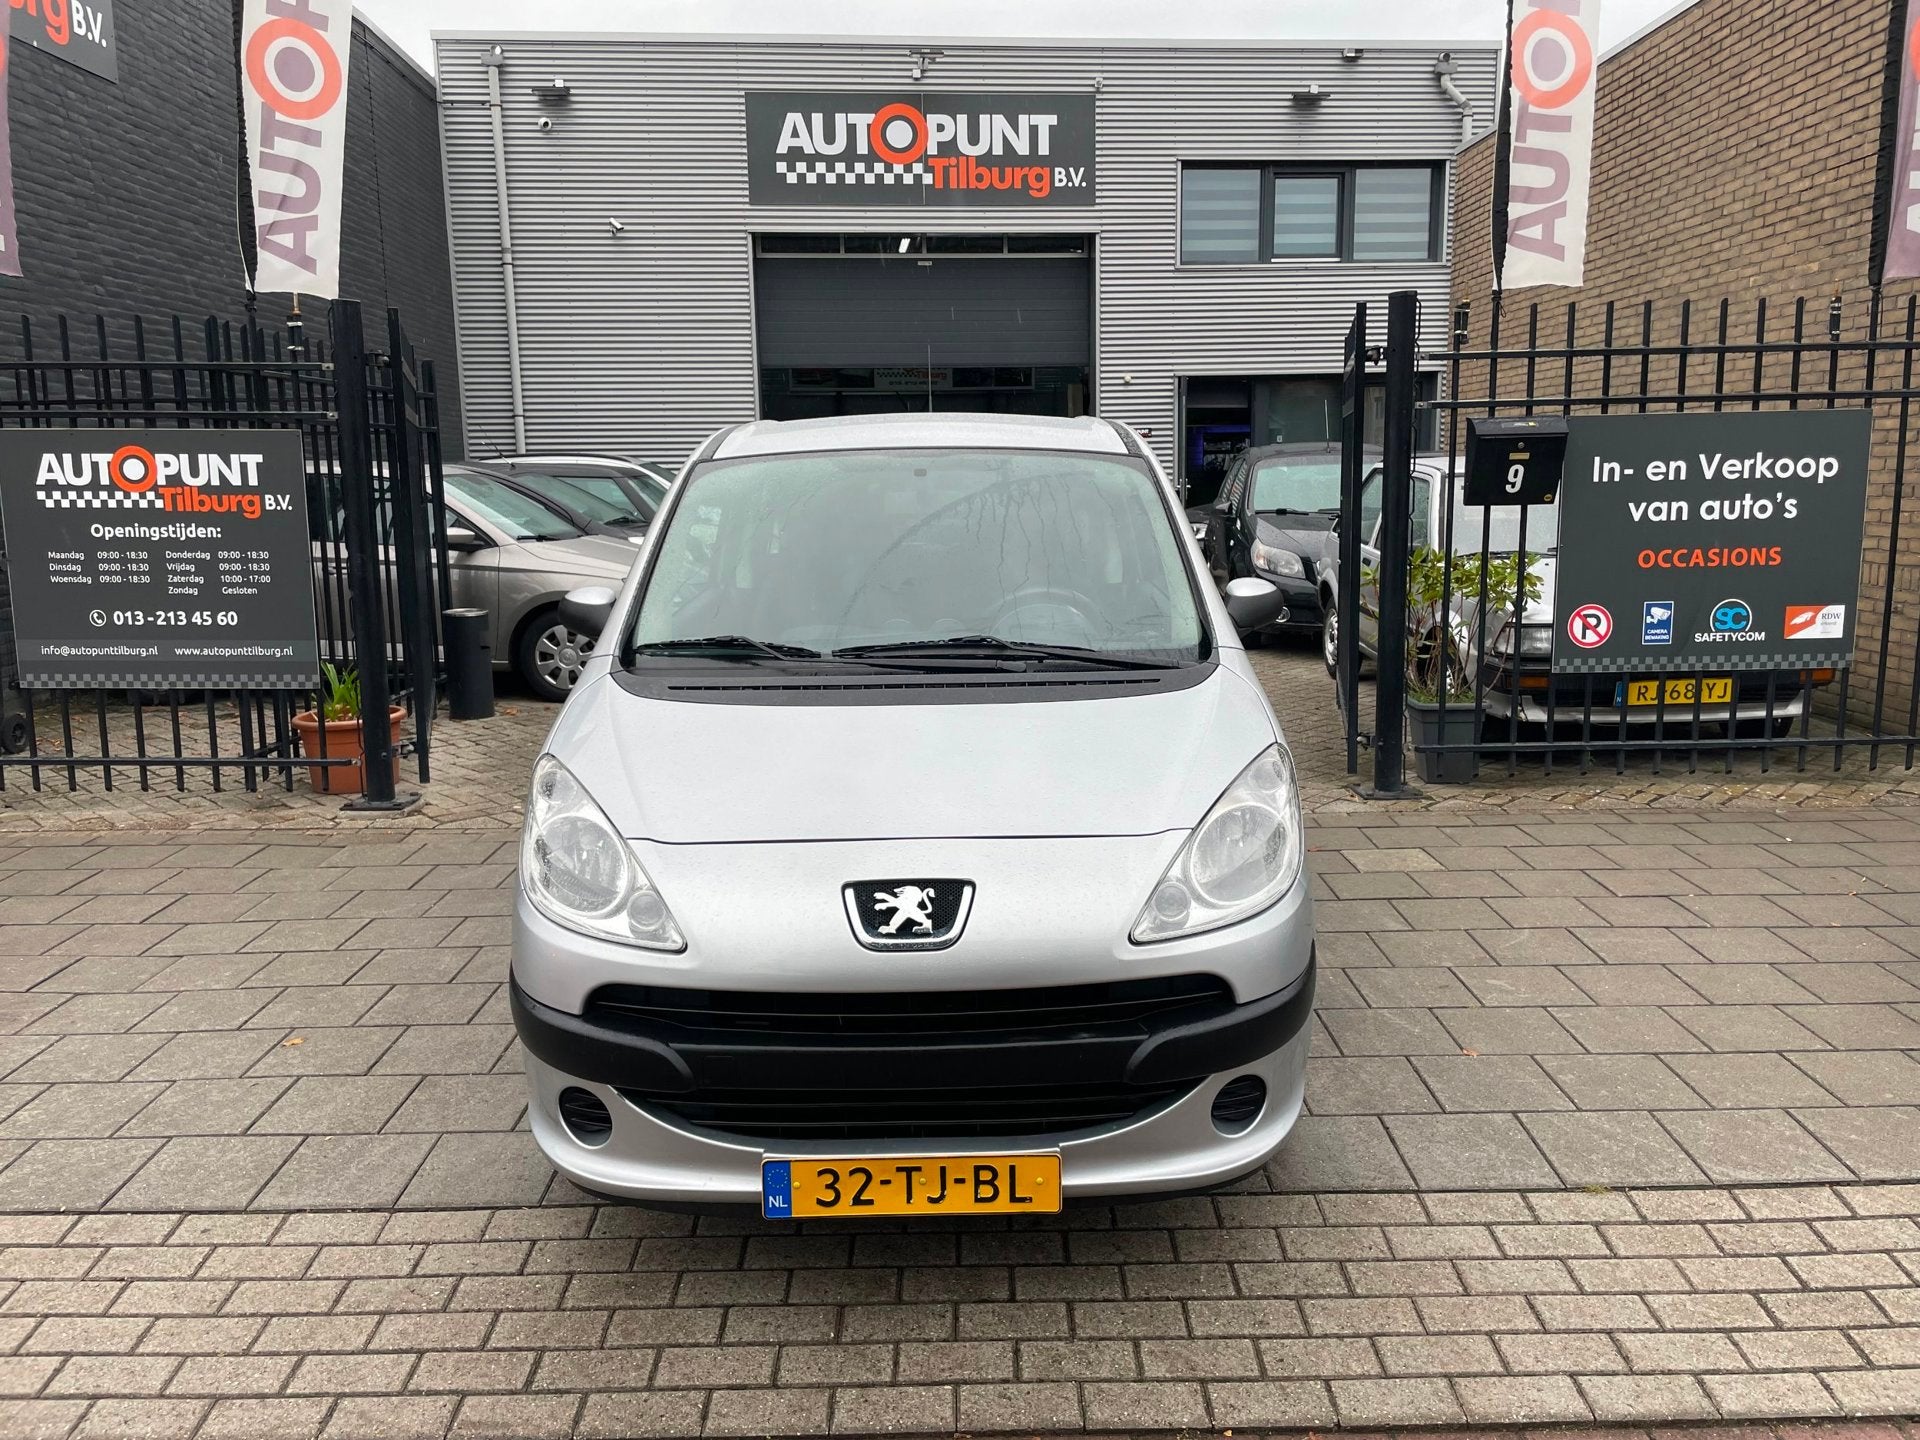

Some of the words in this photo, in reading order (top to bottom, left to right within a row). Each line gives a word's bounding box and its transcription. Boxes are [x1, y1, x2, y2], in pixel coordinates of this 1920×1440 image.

[72, 0, 107, 48] B.V.
[775, 102, 1058, 164] AUTOPUNT
[928, 155, 1051, 198] Tilburg
[1053, 166, 1087, 188] B.V.
[35, 445, 264, 493] AUTOPUNT
[1592, 455, 1635, 484] In-
[1645, 460, 1687, 482] en
[1699, 452, 1840, 483] Verkoop
[1505, 463, 1525, 494] 9
[158, 485, 262, 520] Tilburg
[263, 493, 293, 512] B.V.
[1628, 500, 1690, 523] van
[1699, 492, 1799, 521] auto's
[90, 522, 222, 541] Openingstijden:
[47, 551, 85, 561] Maandag
[96, 551, 120, 560] 09:00
[126, 551, 148, 560] 18:30
[165, 550, 211, 561] Donderdag
[217, 550, 242, 560] 09:00
[246, 550, 270, 560] 18:30
[1637, 546, 1783, 570] OCCASIONS
[48, 562, 82, 573] Dinsdag
[97, 562, 121, 572] 09:00
[127, 562, 150, 572] 18:30
[165, 562, 196, 573] Vrijdag
[218, 562, 243, 572] 09:00
[248, 562, 271, 572] 18:30
[49, 574, 93, 585] Woensdag
[98, 574, 123, 584] 09:00
[128, 574, 151, 584] 18:30
[166, 574, 205, 585] Zaterdag
[219, 574, 244, 584] 10:00
[249, 574, 272, 584] 17:00
[167, 585, 199, 596] Zondag
[221, 585, 259, 595] Gesloten
[190, 610, 214, 627] 45
[215, 610, 239, 627] 60
[1821, 612, 1842, 621] RDW
[1693, 631, 1766, 643] SAFETYCOM
[40, 644, 159, 657] info@autopunttilburg.nl
[174, 645, 294, 658] www.autopunttilburg.nl
[815, 1164, 1034, 1208] 32-TJ-BL
[768, 1194, 789, 1209] NL
